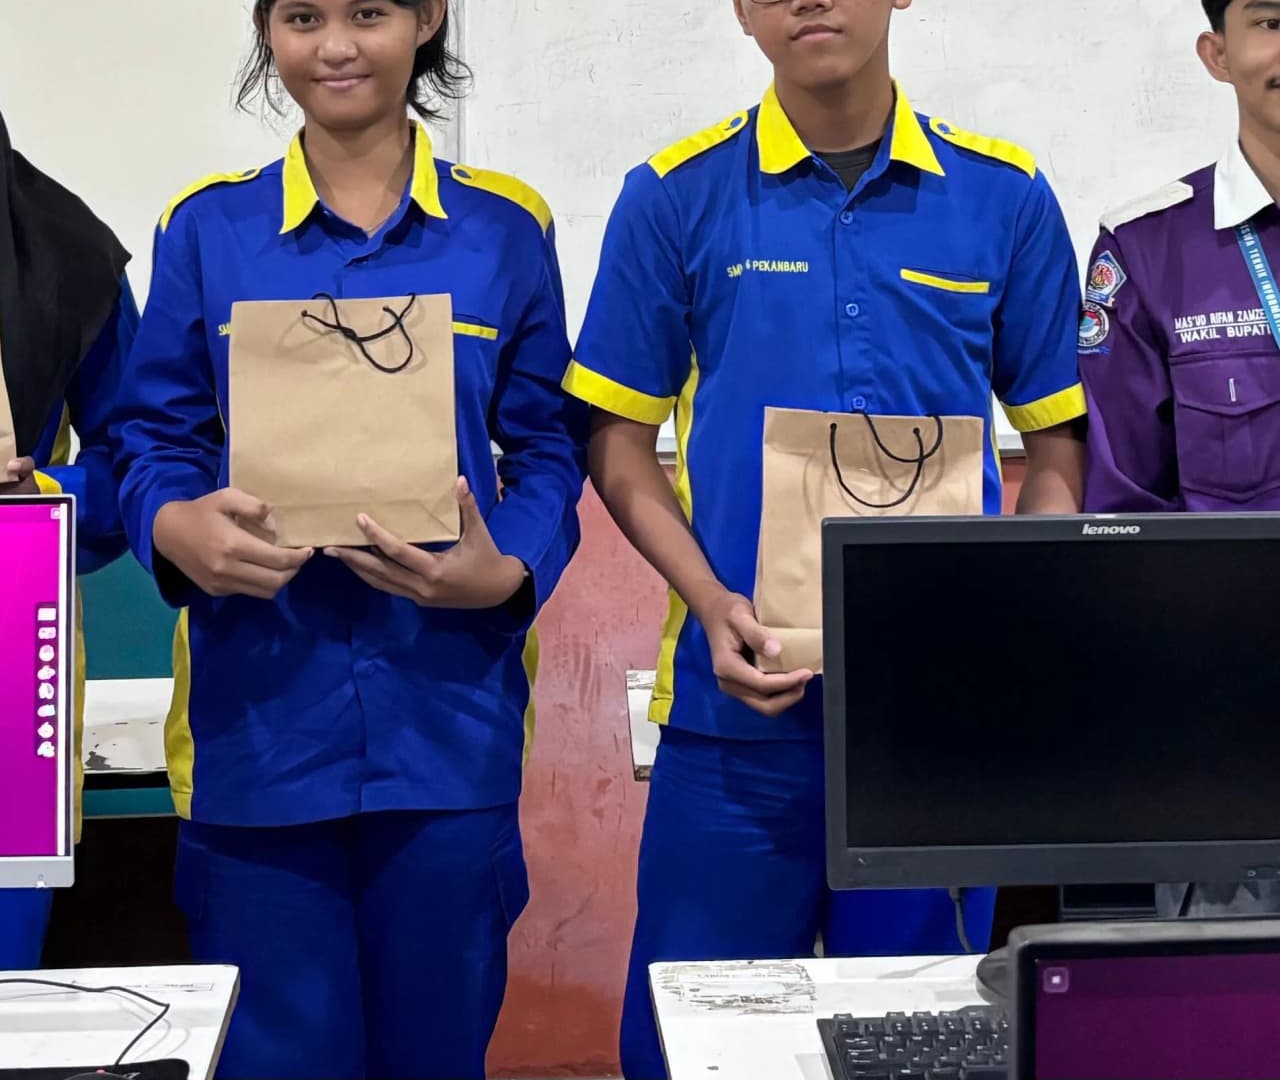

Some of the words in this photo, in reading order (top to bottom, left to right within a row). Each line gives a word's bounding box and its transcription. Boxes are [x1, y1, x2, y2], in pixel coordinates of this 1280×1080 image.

[752, 260, 809, 273] PEKANBARU
[1237, 307, 1267, 322] ZAMZE
[1181, 327, 1221, 343] WAKIL
[1226, 323, 1271, 338] BUPATI
[1082, 523, 1141, 535] lenovo
